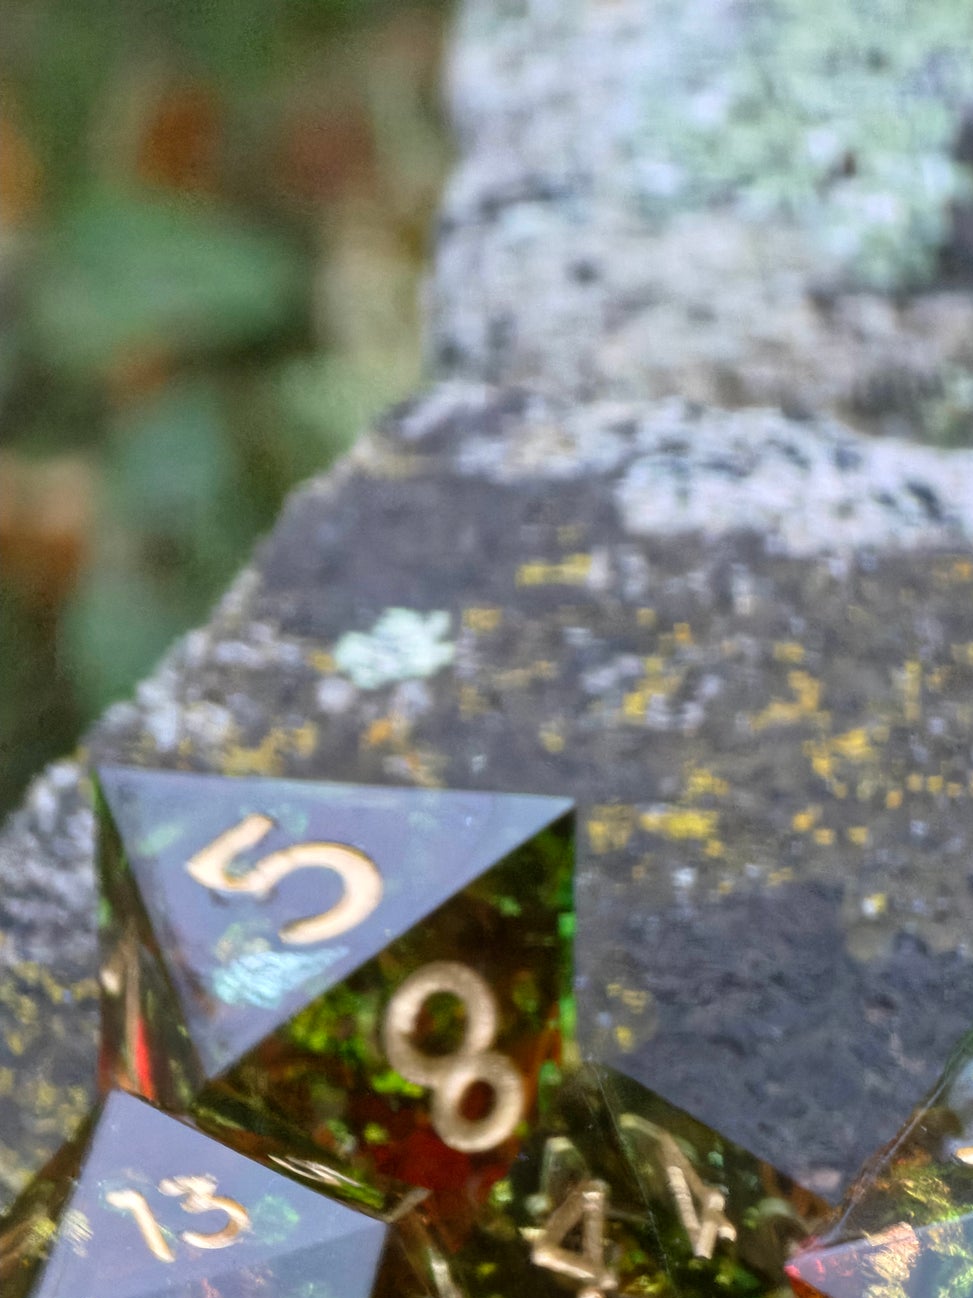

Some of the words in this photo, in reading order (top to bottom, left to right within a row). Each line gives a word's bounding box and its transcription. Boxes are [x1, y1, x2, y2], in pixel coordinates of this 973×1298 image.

[186, 813, 384, 945] 5
[385, 961, 526, 1153] 8
[105, 1173, 252, 1264] 13
